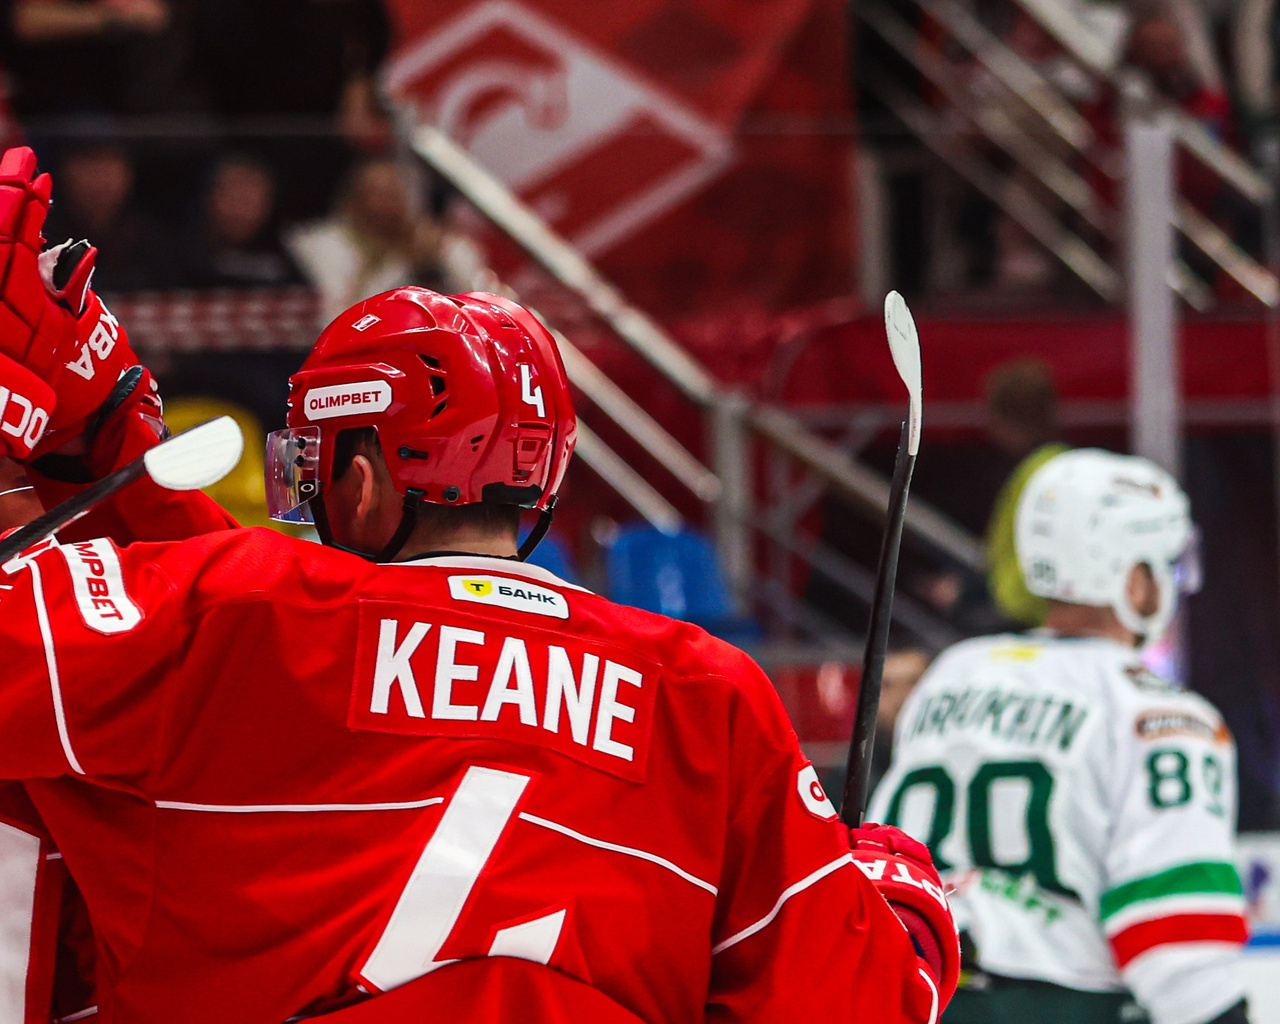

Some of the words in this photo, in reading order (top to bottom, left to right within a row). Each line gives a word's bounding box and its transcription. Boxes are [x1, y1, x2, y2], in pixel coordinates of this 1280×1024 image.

[309, 390, 382, 411] OLIMPBET
[520, 364, 546, 418] 4
[498, 586, 556, 606] БАНК
[370, 618, 643, 762] KEANE
